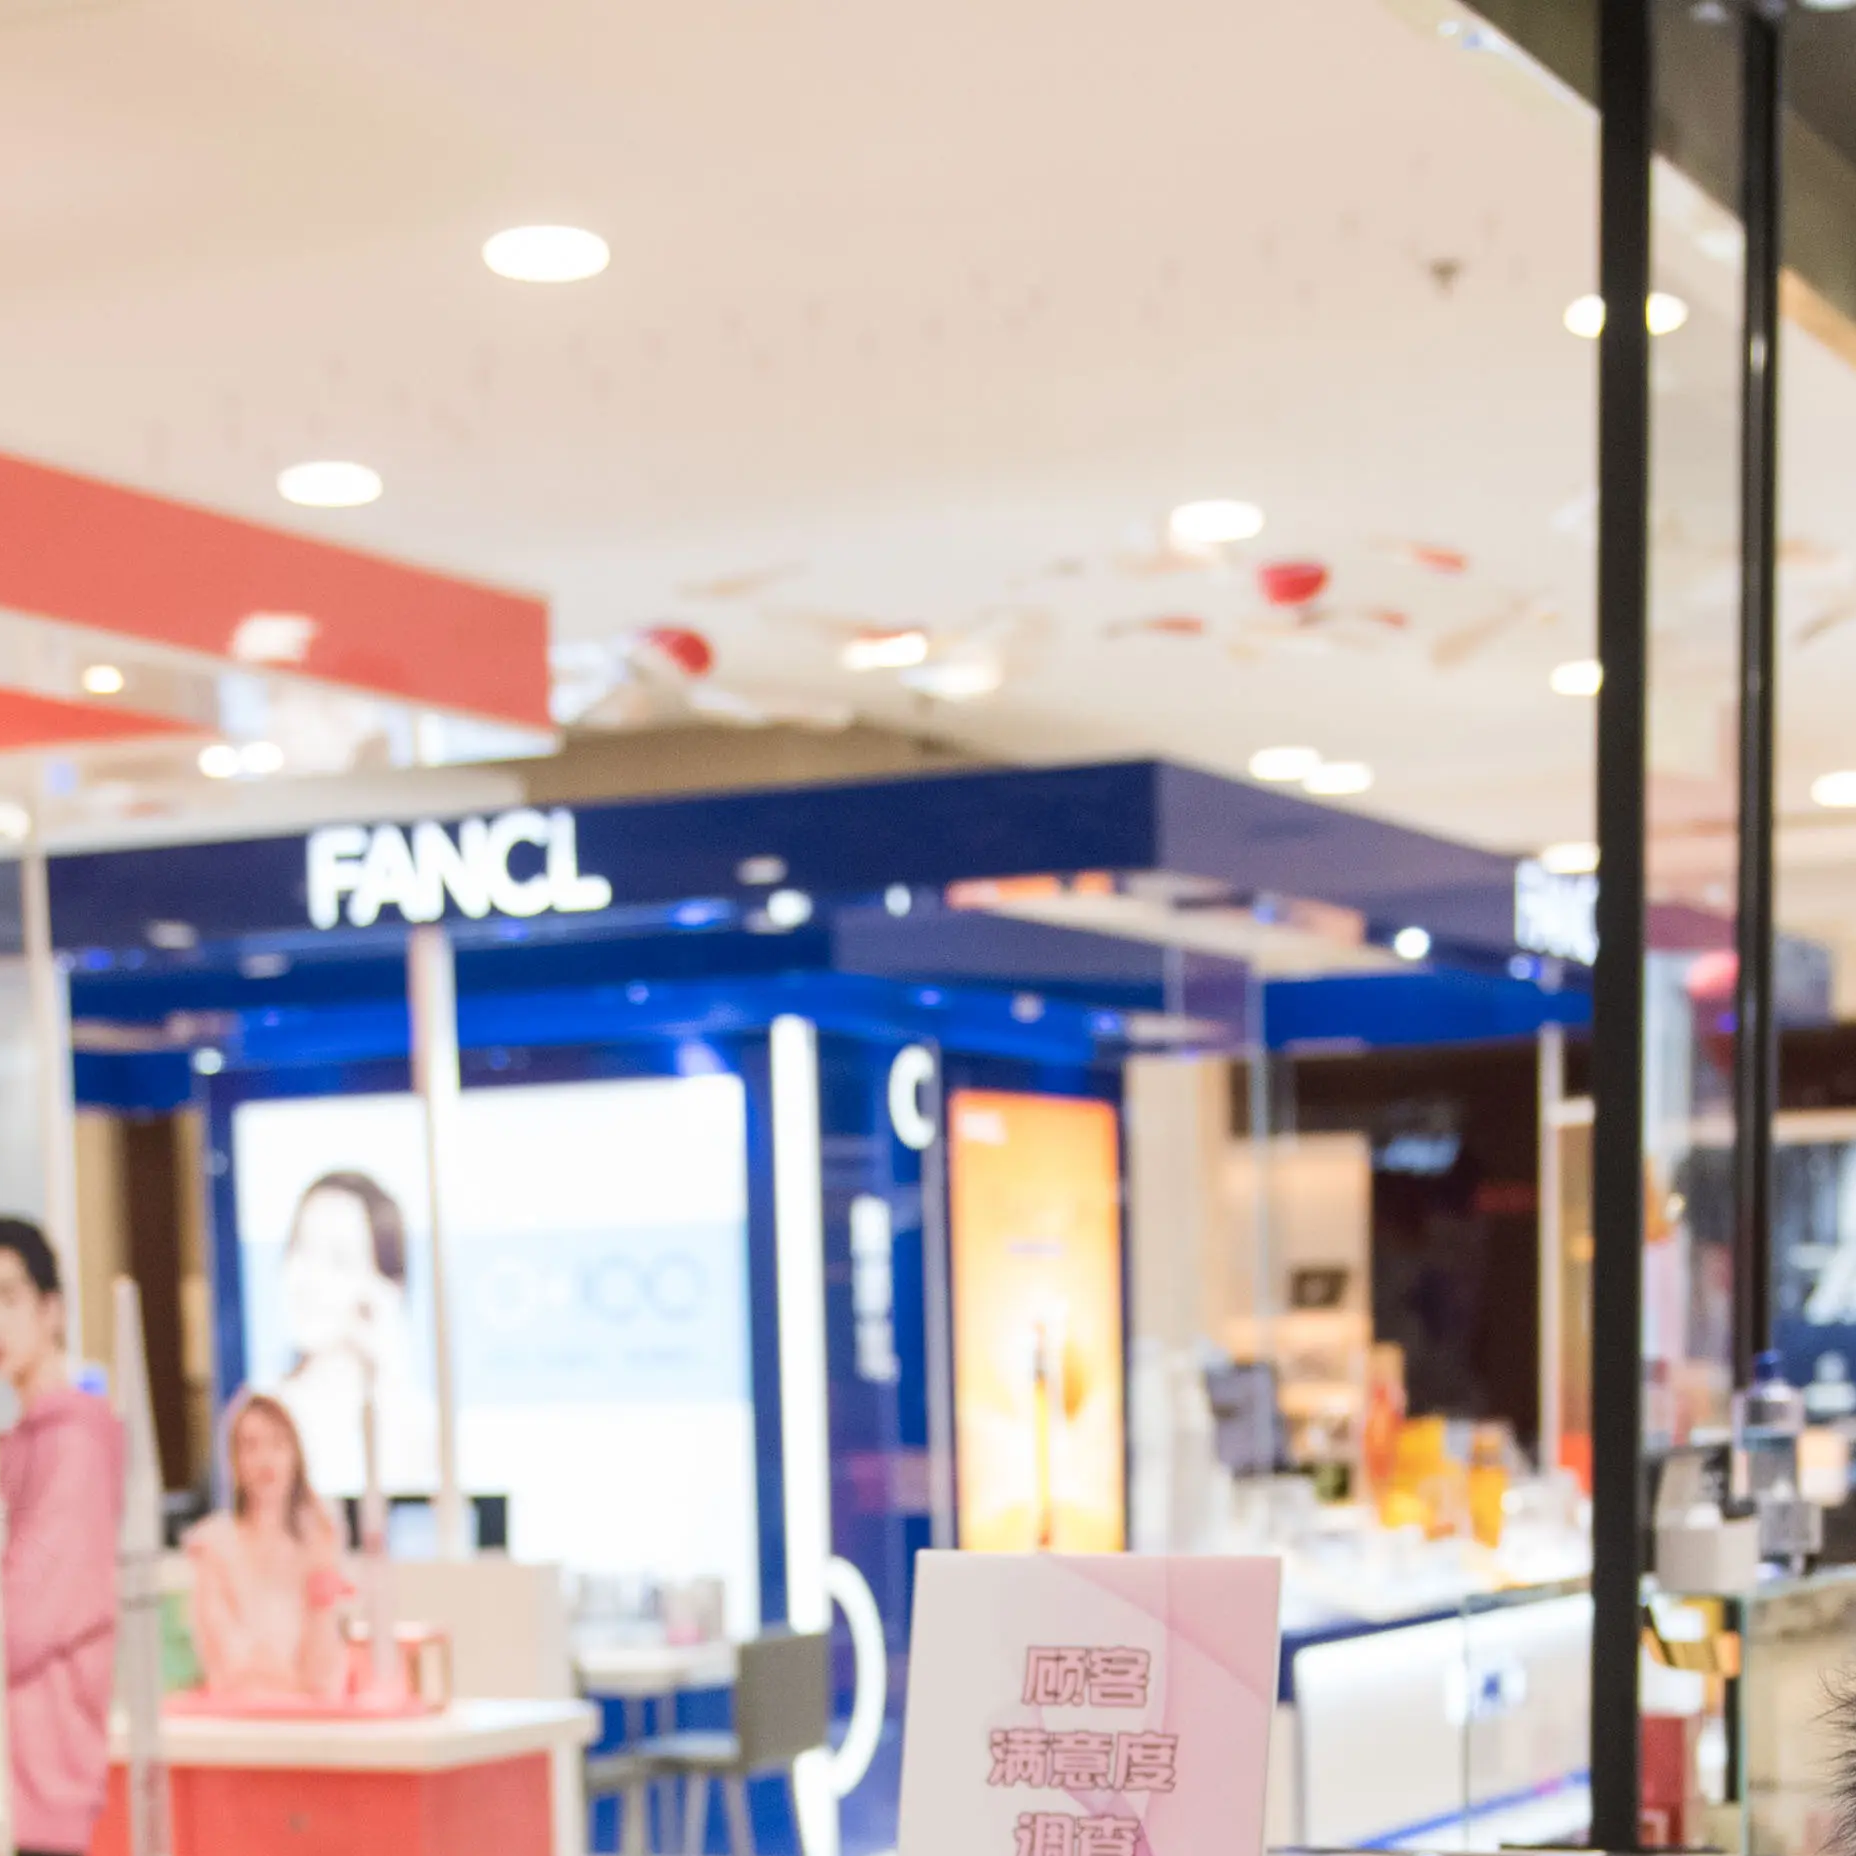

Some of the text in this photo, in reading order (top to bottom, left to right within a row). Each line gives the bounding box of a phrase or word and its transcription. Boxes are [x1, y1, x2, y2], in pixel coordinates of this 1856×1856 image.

[306, 807, 613, 929] FANCL
[1021, 1643, 1151, 1709] 顾客
[986, 1728, 1180, 1794] 满意度
